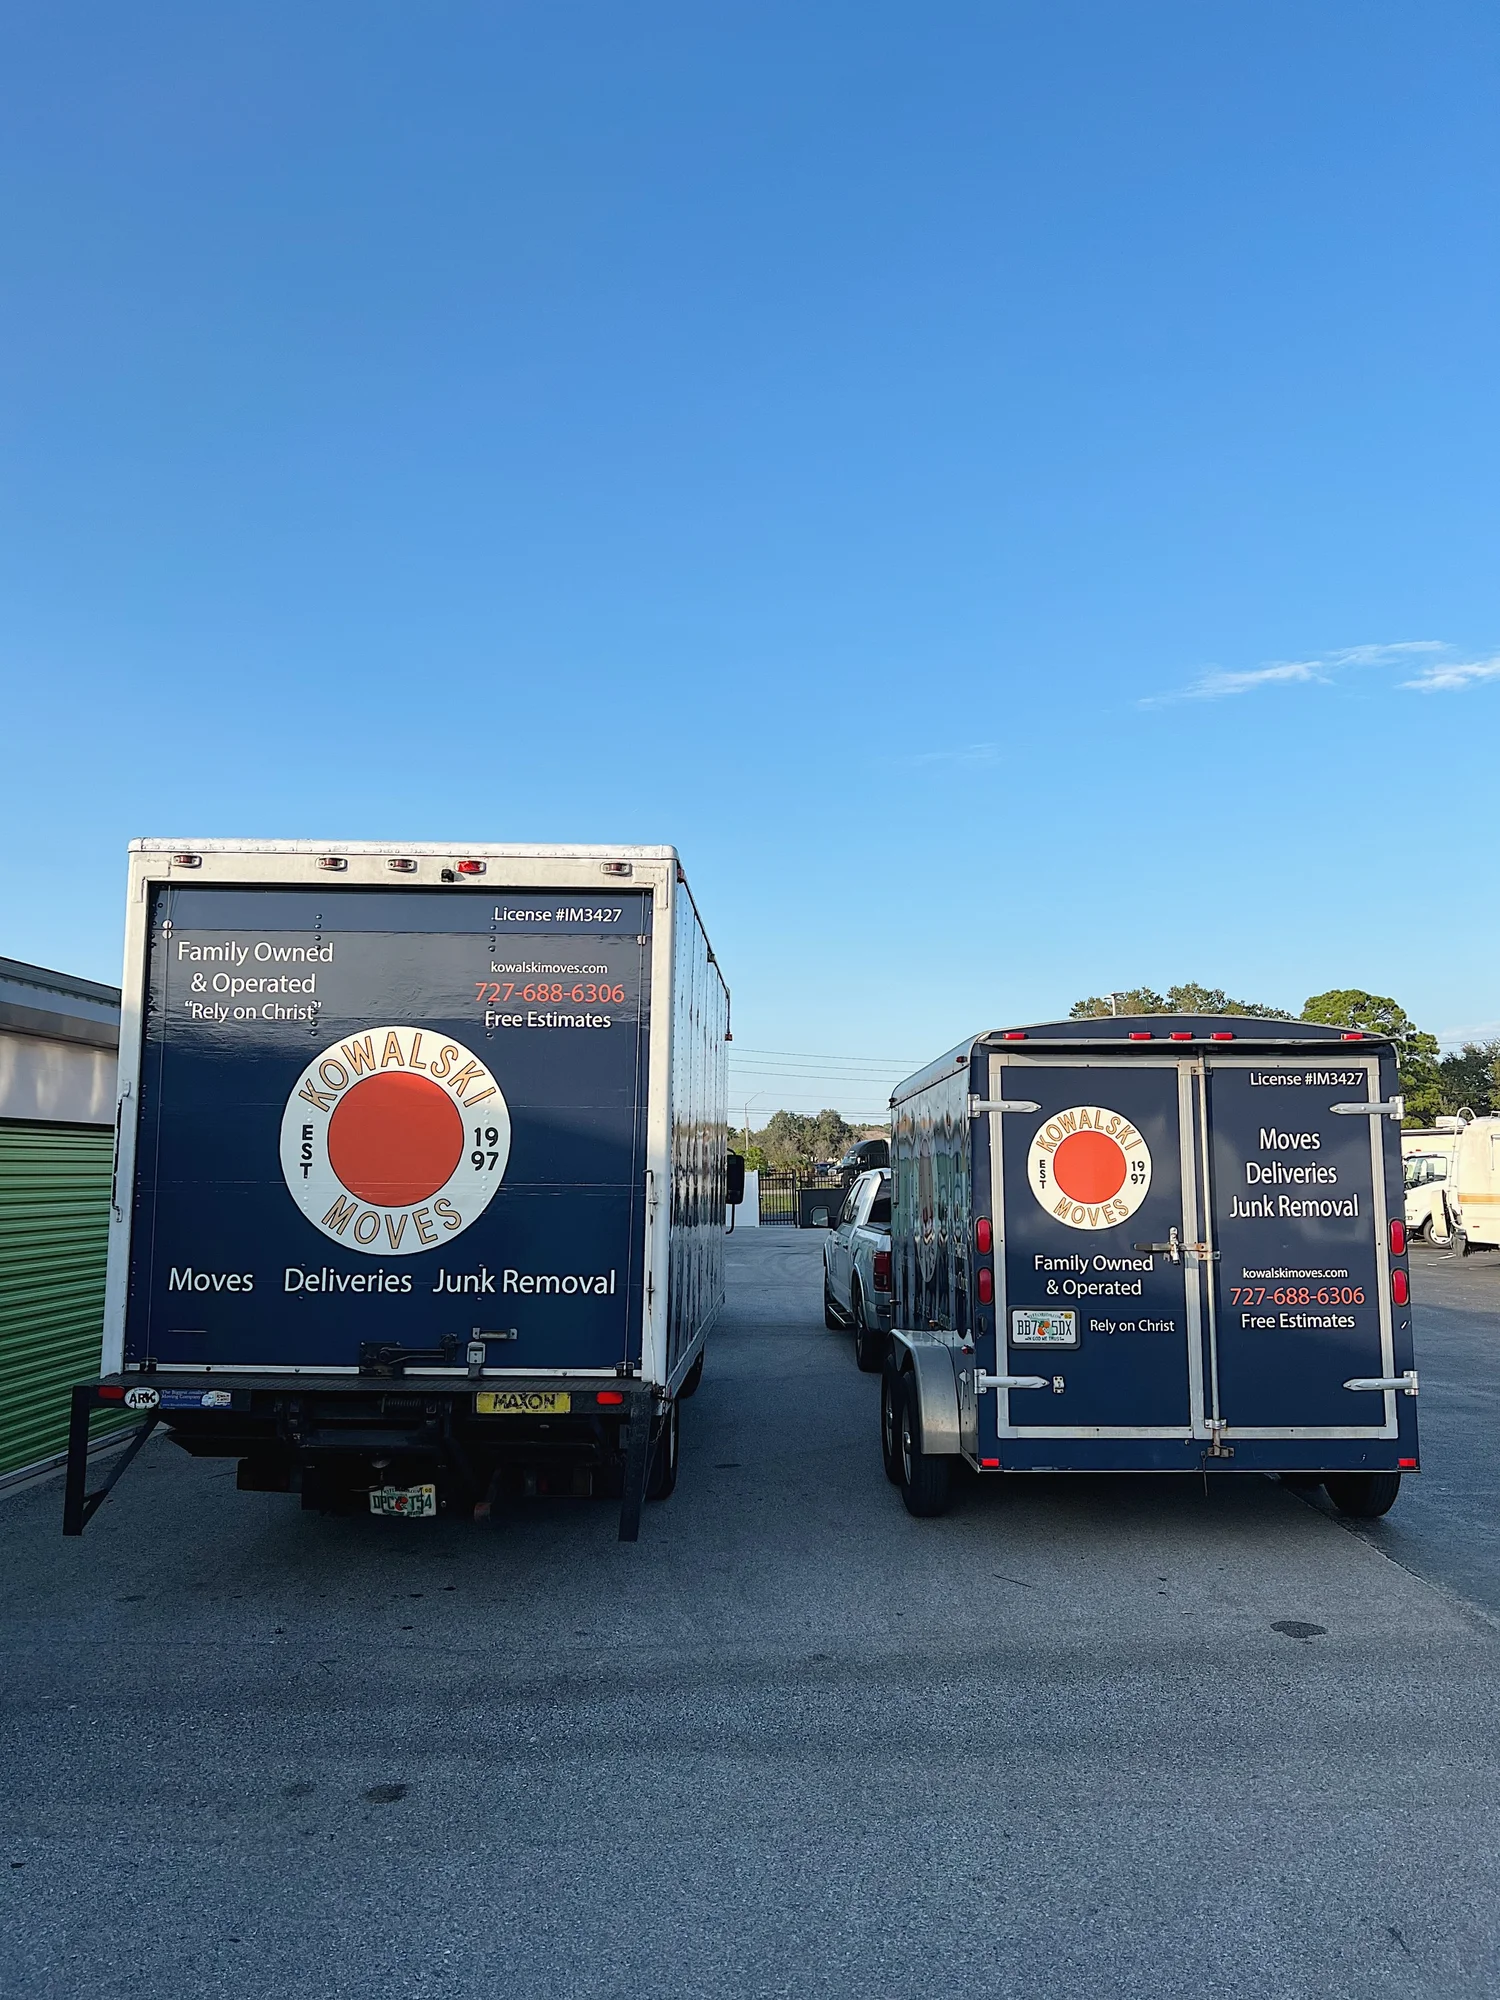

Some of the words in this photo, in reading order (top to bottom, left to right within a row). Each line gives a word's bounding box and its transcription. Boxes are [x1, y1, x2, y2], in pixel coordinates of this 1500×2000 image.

[494, 907, 551, 921] License
[555, 908, 622, 922] #IM3427
[178, 941, 249, 966] Family
[254, 942, 334, 962] Owned
[490, 961, 608, 974] kowalskimoves.com
[190, 972, 207, 992] &
[212, 973, 316, 997] Operated
[475, 982, 625, 1003] 727-688-6306
[233, 1006, 257, 1019] on
[485, 1011, 523, 1027] Free
[527, 1011, 611, 1028] Estimates
[298, 1031, 497, 1113] KOWALSKI
[1250, 1072, 1302, 1086] License
[1305, 1072, 1364, 1086] #IM3427
[474, 1127, 499, 1147] 19
[1035, 1109, 1143, 1153] KOWALSKI
[1259, 1127, 1321, 1150] Moves
[471, 1151, 499, 1171] 97
[1131, 1161, 1145, 1172] 19
[1130, 1173, 1146, 1185] 97
[1246, 1160, 1338, 1184] Deliveries
[1053, 1197, 1129, 1227] MOVES
[1229, 1194, 1275, 1218] Junk
[1278, 1193, 1360, 1217] Removal
[321, 1194, 462, 1250] MOVES
[1034, 1254, 1089, 1275] Family
[1092, 1254, 1154, 1271] Owned
[1242, 1267, 1348, 1279] kowalskimoves.com
[168, 1267, 254, 1292] Moves
[284, 1267, 412, 1293] Deliveries
[432, 1268, 496, 1293] Junk
[502, 1269, 616, 1295] Removal
[1046, 1279, 1059, 1296] &
[1062, 1279, 1142, 1299] Operated
[1230, 1287, 1365, 1306] 727-688-6306
[1090, 1319, 1117, 1335] Rely
[1119, 1322, 1136, 1332] on
[1138, 1320, 1175, 1332] Christ
[1241, 1313, 1276, 1329] Free
[1279, 1313, 1356, 1329] Estimates
[493, 1394, 556, 1410] MAXON
